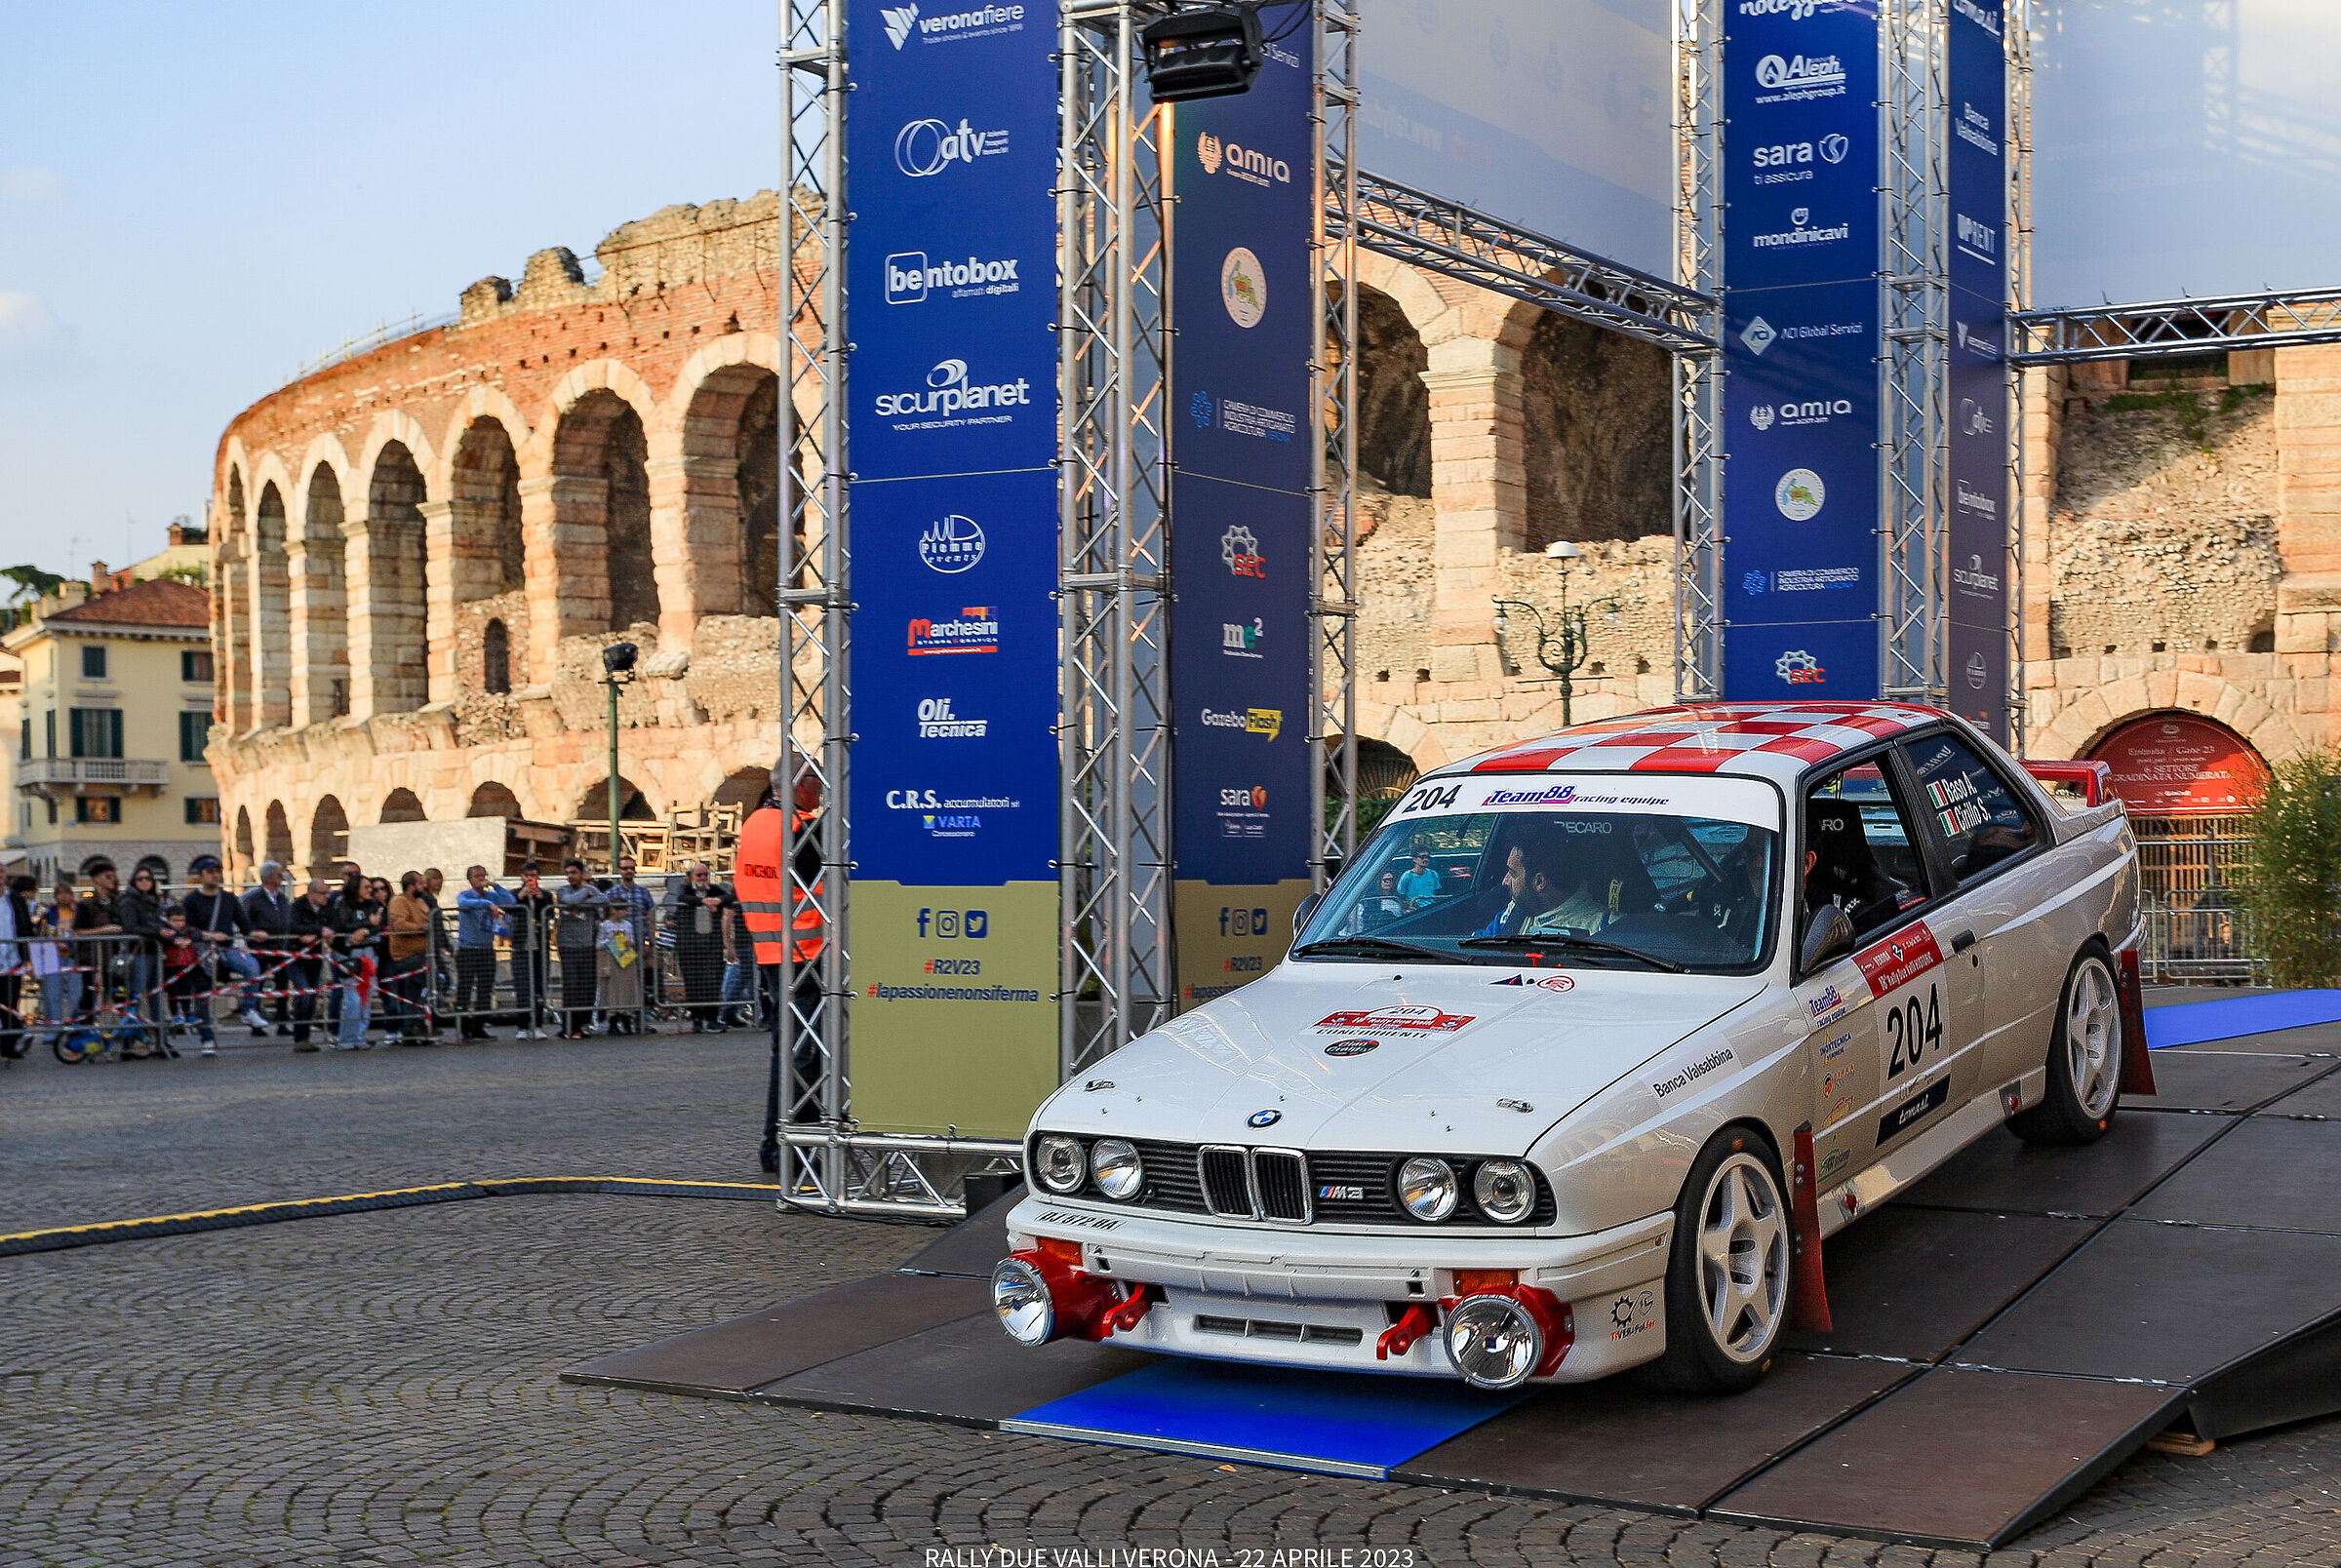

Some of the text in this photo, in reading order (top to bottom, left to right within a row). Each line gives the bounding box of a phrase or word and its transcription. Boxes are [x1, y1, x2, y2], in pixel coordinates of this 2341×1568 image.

[919, 4, 1024, 34] veronafiere
[1786, 55, 1841, 78] Aleph
[1756, 85, 1845, 104] www.alephgroup.it
[939, 118, 986, 163] atv
[1225, 143, 1290, 183] amia
[1753, 142, 1813, 168] sara
[1764, 171, 1813, 184] assicura
[1753, 222, 1848, 247] mondinicavi
[890, 257, 1018, 292] bentobox
[875, 375, 1030, 416] sicurplanet
[1779, 400, 1852, 418] amia
[893, 415, 1012, 431] YOUR SECURITY PARTNER
[1233, 553, 1266, 578] SEC
[1790, 668, 1826, 683] SEC
[918, 698, 956, 721] Oli.
[919, 722, 987, 738] Tecnica
[1940, 770, 1978, 804] Baso A.
[2111, 771, 2173, 781] RADINATA
[886, 790, 942, 809] C.R.S.
[1220, 789, 1250, 806] sara
[1403, 784, 1462, 813] 204
[1488, 785, 1670, 805] Team88 racing equipe
[937, 816, 982, 828] VARTA
[1954, 796, 1992, 832] Cirillo S.
[924, 960, 981, 974] #R2V23
[868, 983, 1039, 1002] #lapassionenonsiferma
[1809, 985, 1838, 1014] Team88
[1816, 1015, 1832, 1028] racing
[1886, 982, 1943, 1081] 204
[1652, 1047, 1733, 1098] Banca Valsabbina
[1330, 1186, 1364, 1199] M3
